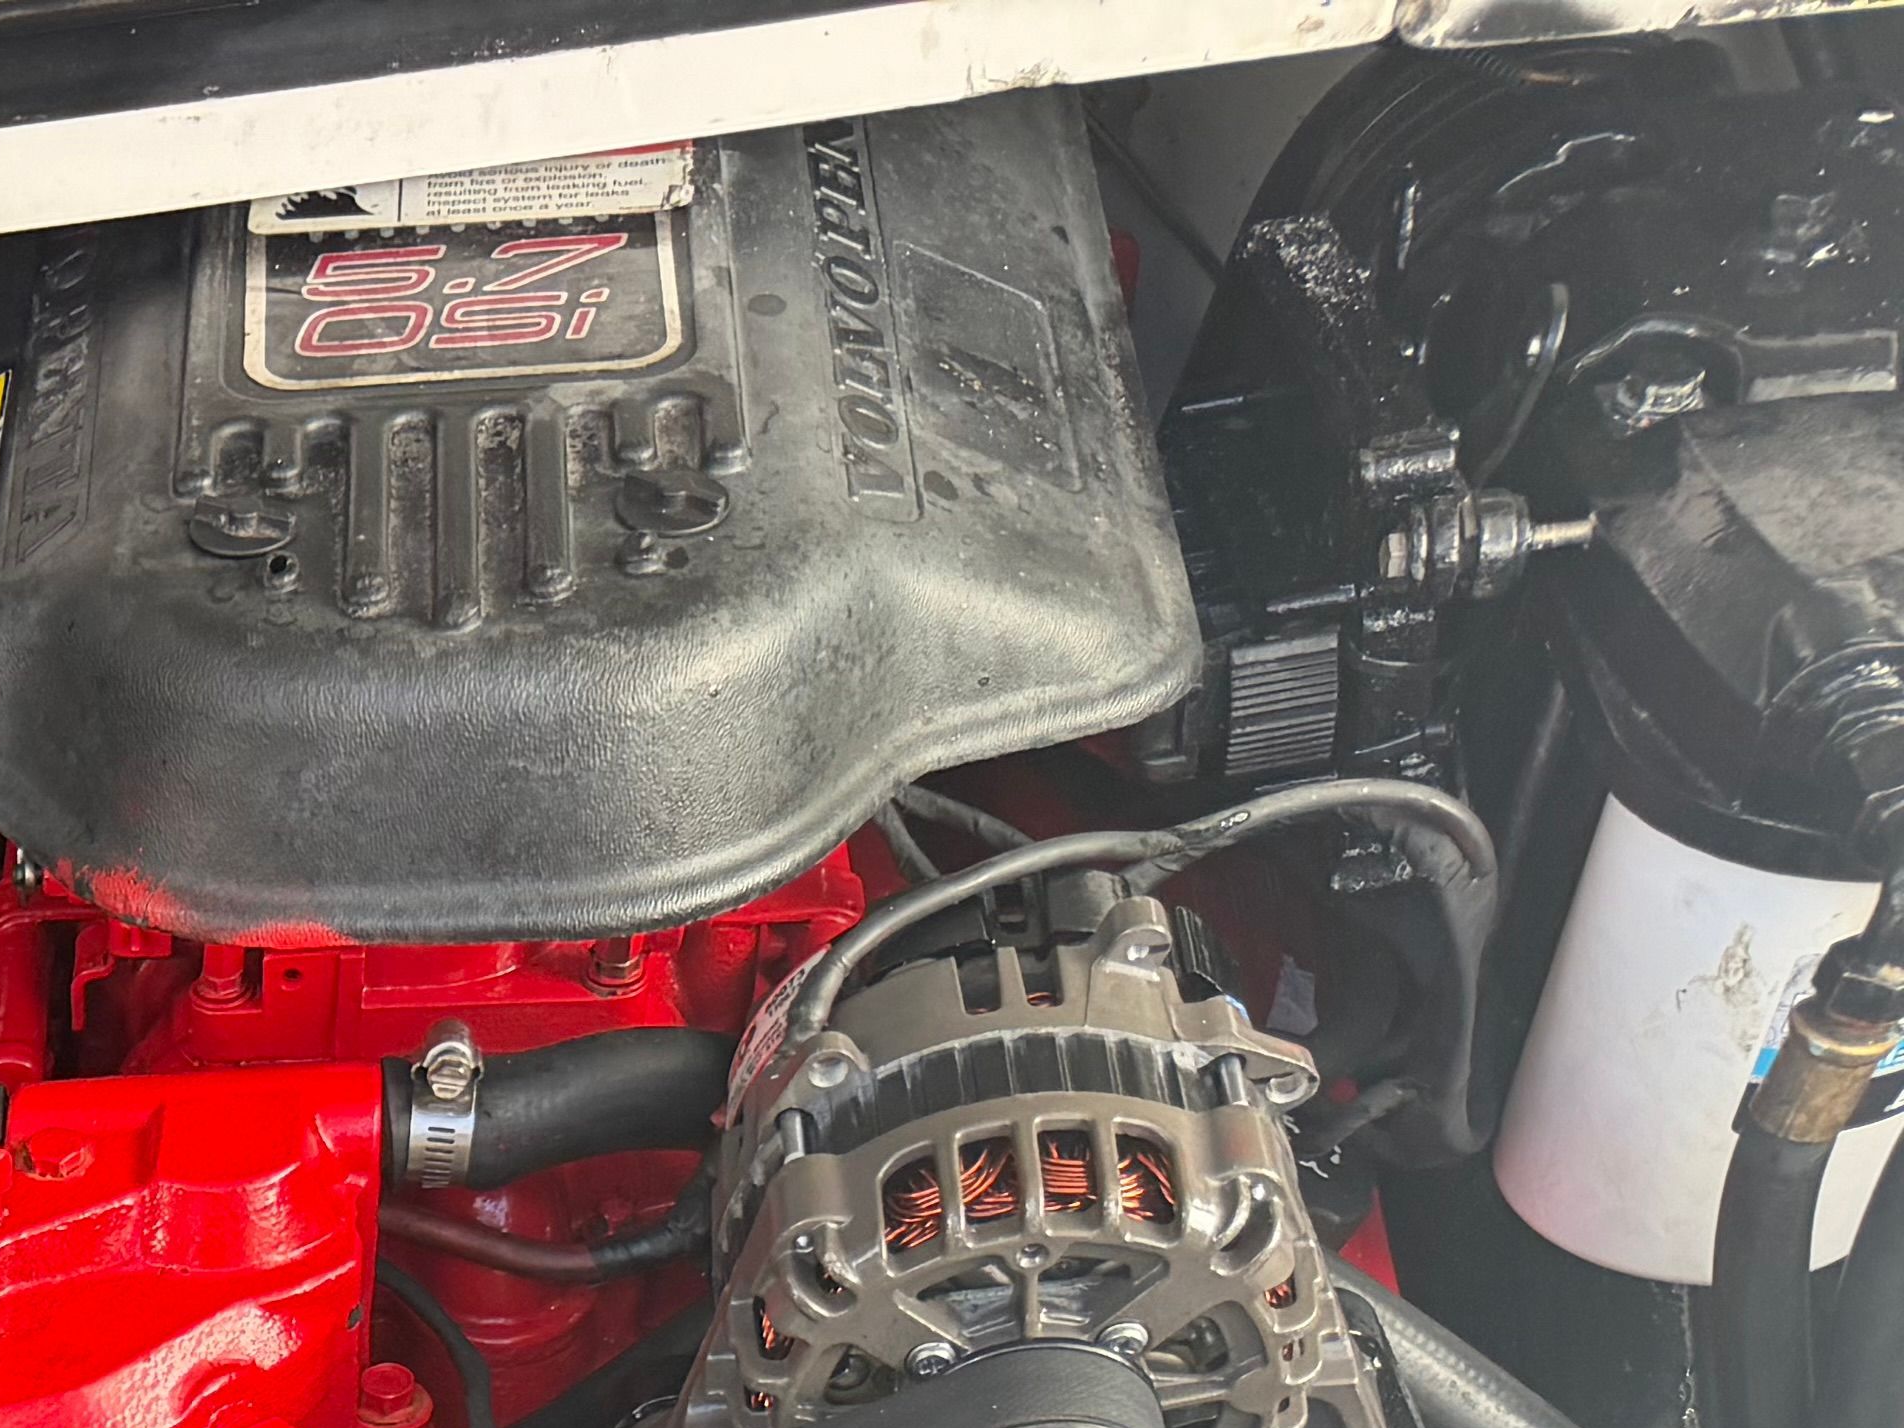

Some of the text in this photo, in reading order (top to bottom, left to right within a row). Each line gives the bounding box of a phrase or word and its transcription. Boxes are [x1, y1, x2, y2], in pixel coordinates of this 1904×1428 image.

[478, 163, 539, 176] serious
[544, 161, 590, 174] injury
[595, 161, 612, 170] or
[618, 157, 666, 169] death
[426, 186, 498, 198] resulting
[503, 183, 541, 194] from
[546, 180, 607, 193] leaking
[427, 179, 464, 189] from
[469, 176, 497, 187] fire
[501, 175, 518, 184] or
[426, 189, 630, 208] Inspect system for leaks
[426, 208, 442, 217] at
[446, 206, 487, 216] least
[492, 204, 534, 213] once
[301, 232, 629, 301] 5.7
[825, 254, 906, 500] VOLVO
